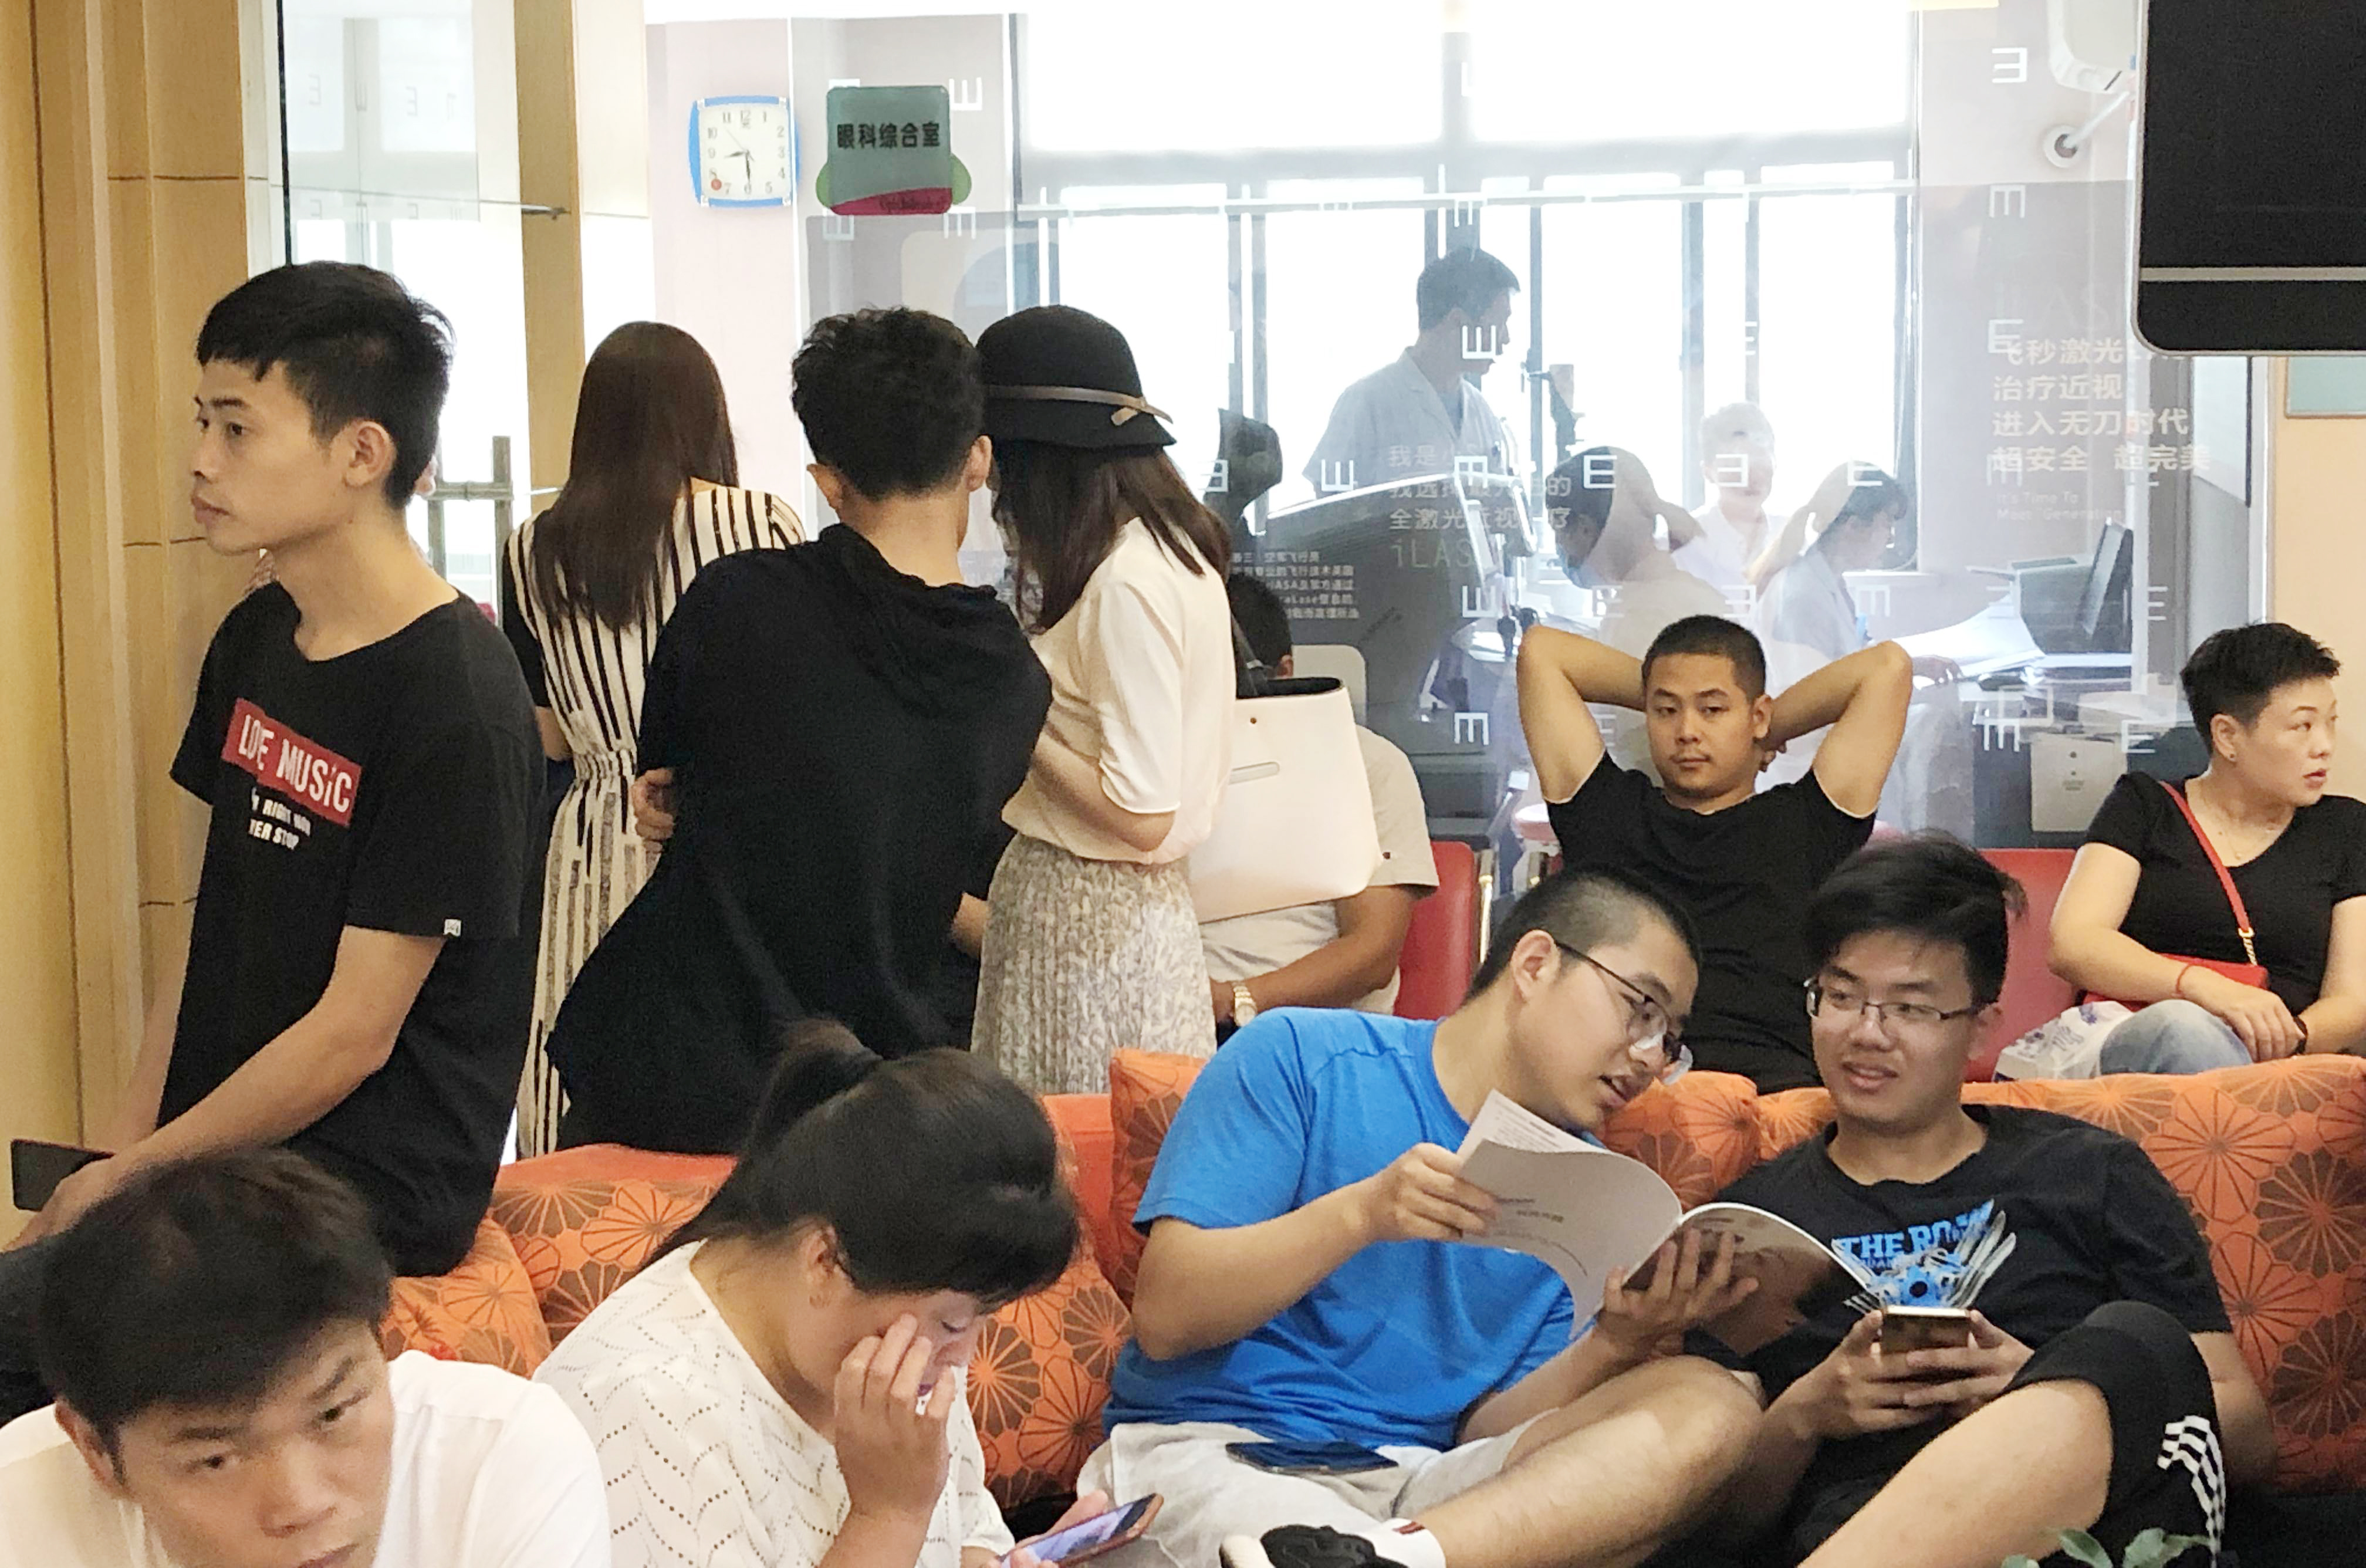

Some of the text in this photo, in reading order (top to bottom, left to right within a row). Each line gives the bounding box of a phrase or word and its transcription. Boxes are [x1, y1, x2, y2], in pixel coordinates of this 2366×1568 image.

[837, 121, 941, 150] 眼科综合室
[1993, 374, 2124, 402] 治疗近视
[1992, 408, 2189, 437] 进入无刀时代
